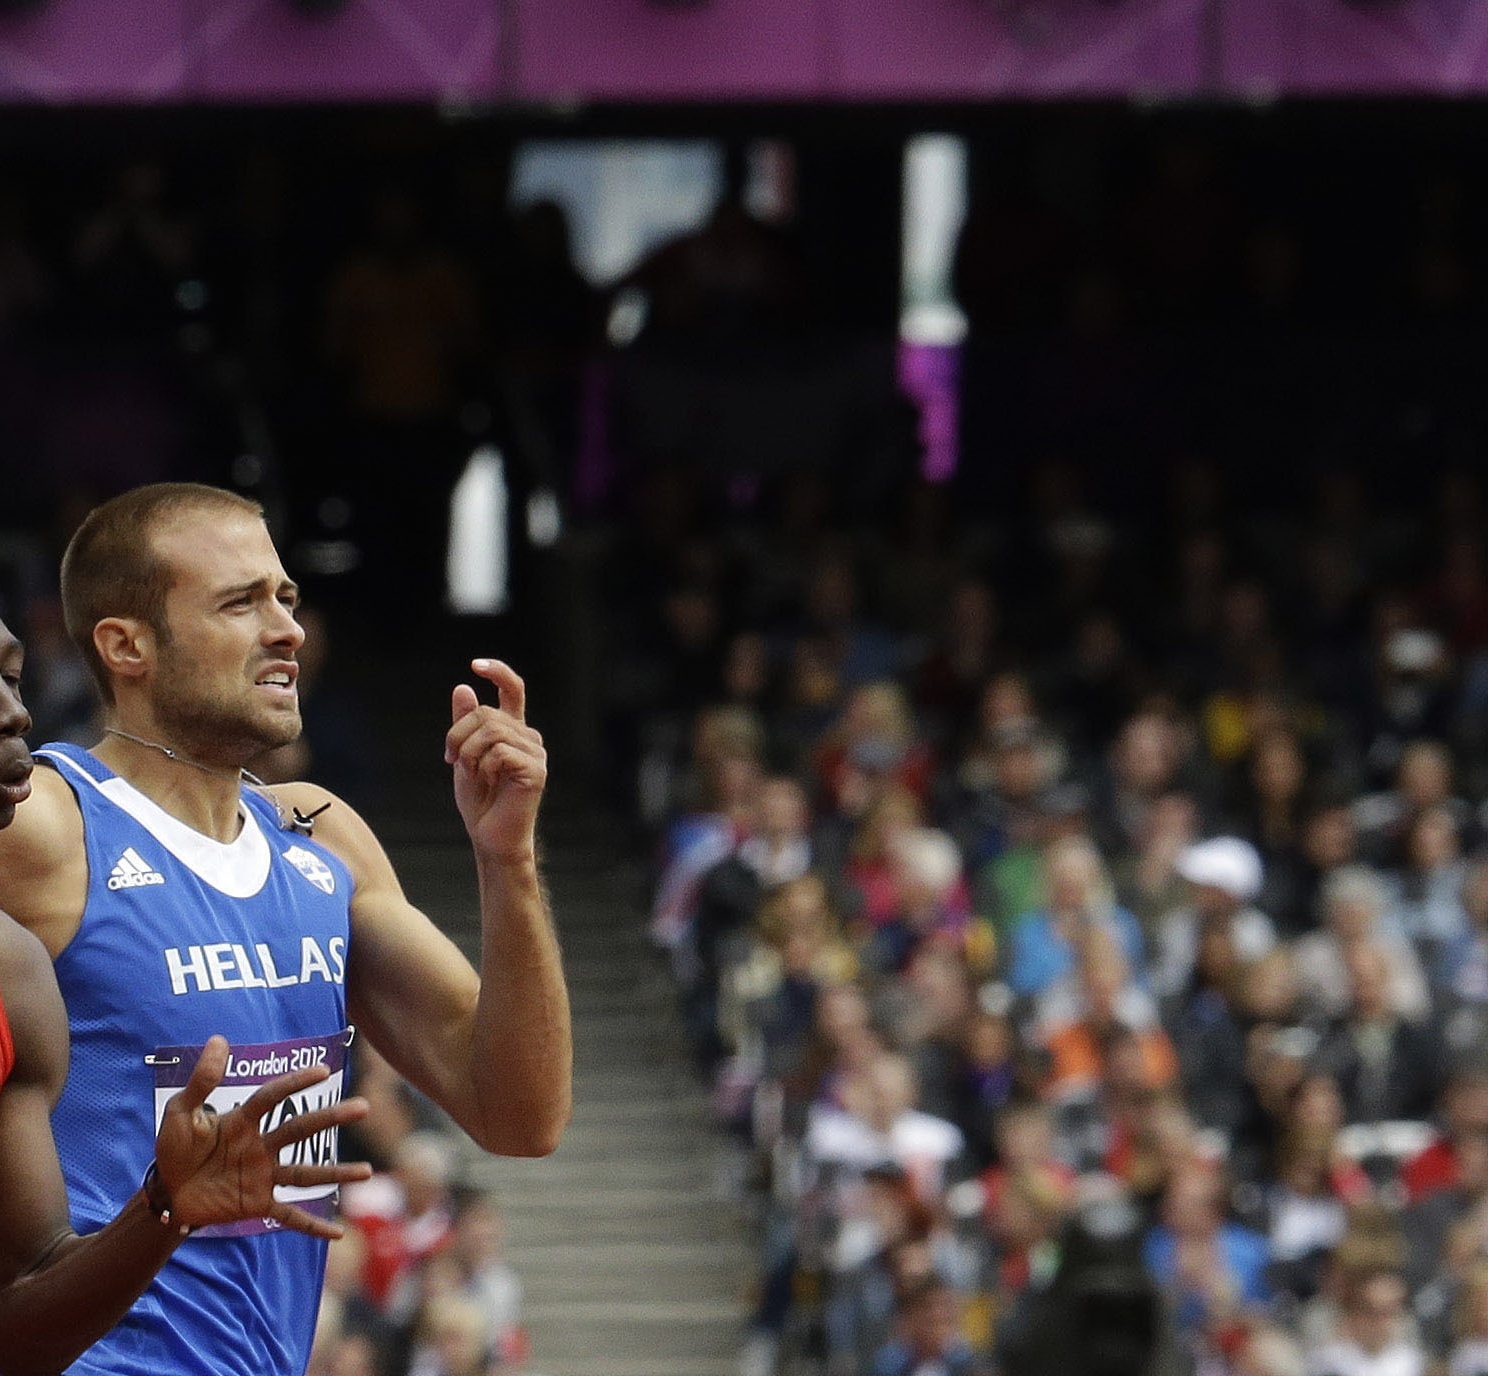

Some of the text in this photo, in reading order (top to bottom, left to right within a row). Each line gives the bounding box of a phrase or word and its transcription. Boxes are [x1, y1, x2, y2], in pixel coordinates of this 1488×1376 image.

[107, 870, 166, 891] adidas
[164, 936, 345, 995] HELLAS
[225, 1046, 328, 1078] London 2012
